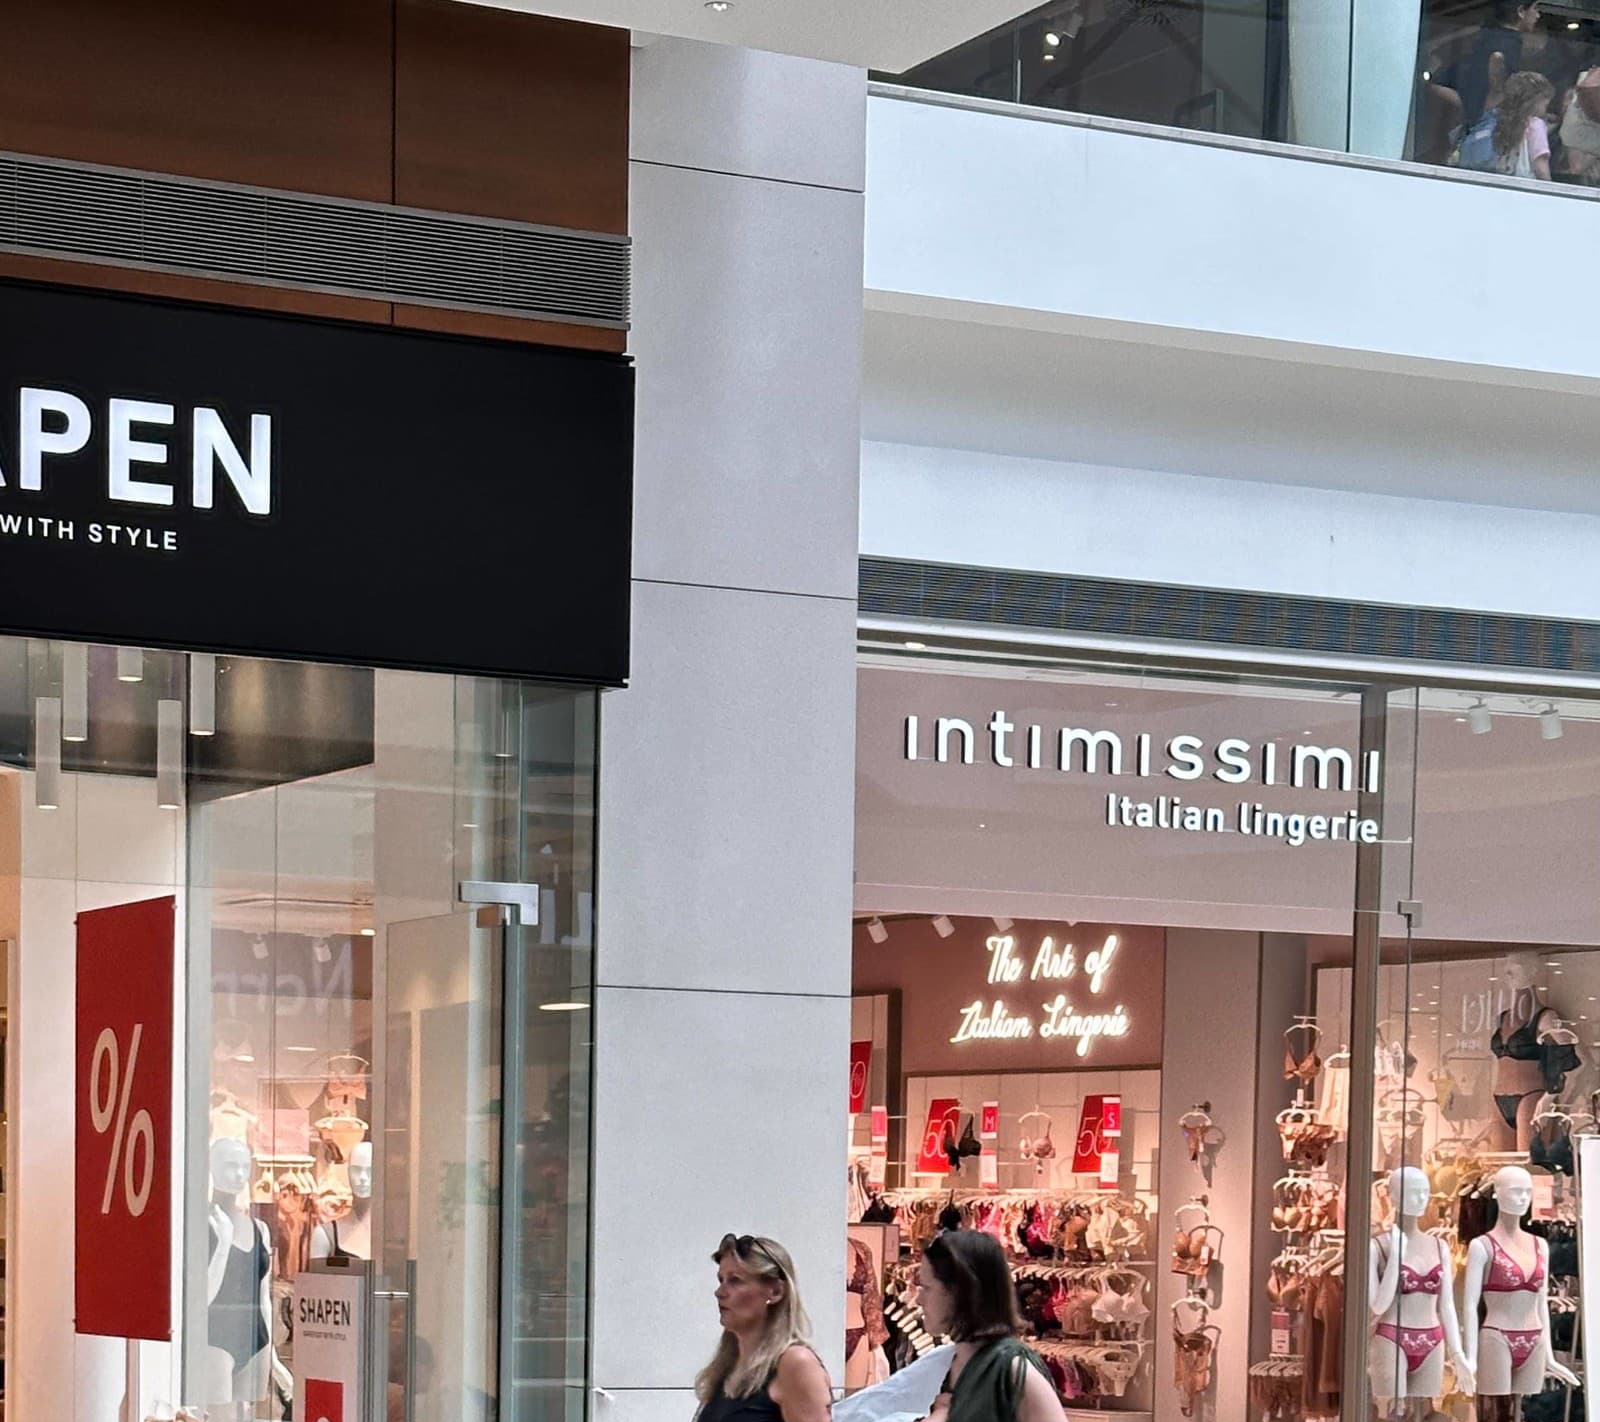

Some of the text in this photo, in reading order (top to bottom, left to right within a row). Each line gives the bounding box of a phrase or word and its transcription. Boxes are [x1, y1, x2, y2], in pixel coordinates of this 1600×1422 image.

[0, 386, 272, 516] PEN
[0, 514, 178, 550] WITH STYLE
[904, 710, 1380, 793] intimissimi
[1105, 793, 1379, 846] Italian lingerie
[986, 934, 1118, 993] The Art of
[950, 994, 1129, 1057] Italian Lingerie
[985, 1115, 995, 1129] M
[1108, 1112, 1116, 1127] S
[300, 1297, 350, 1326] SHAPEN
